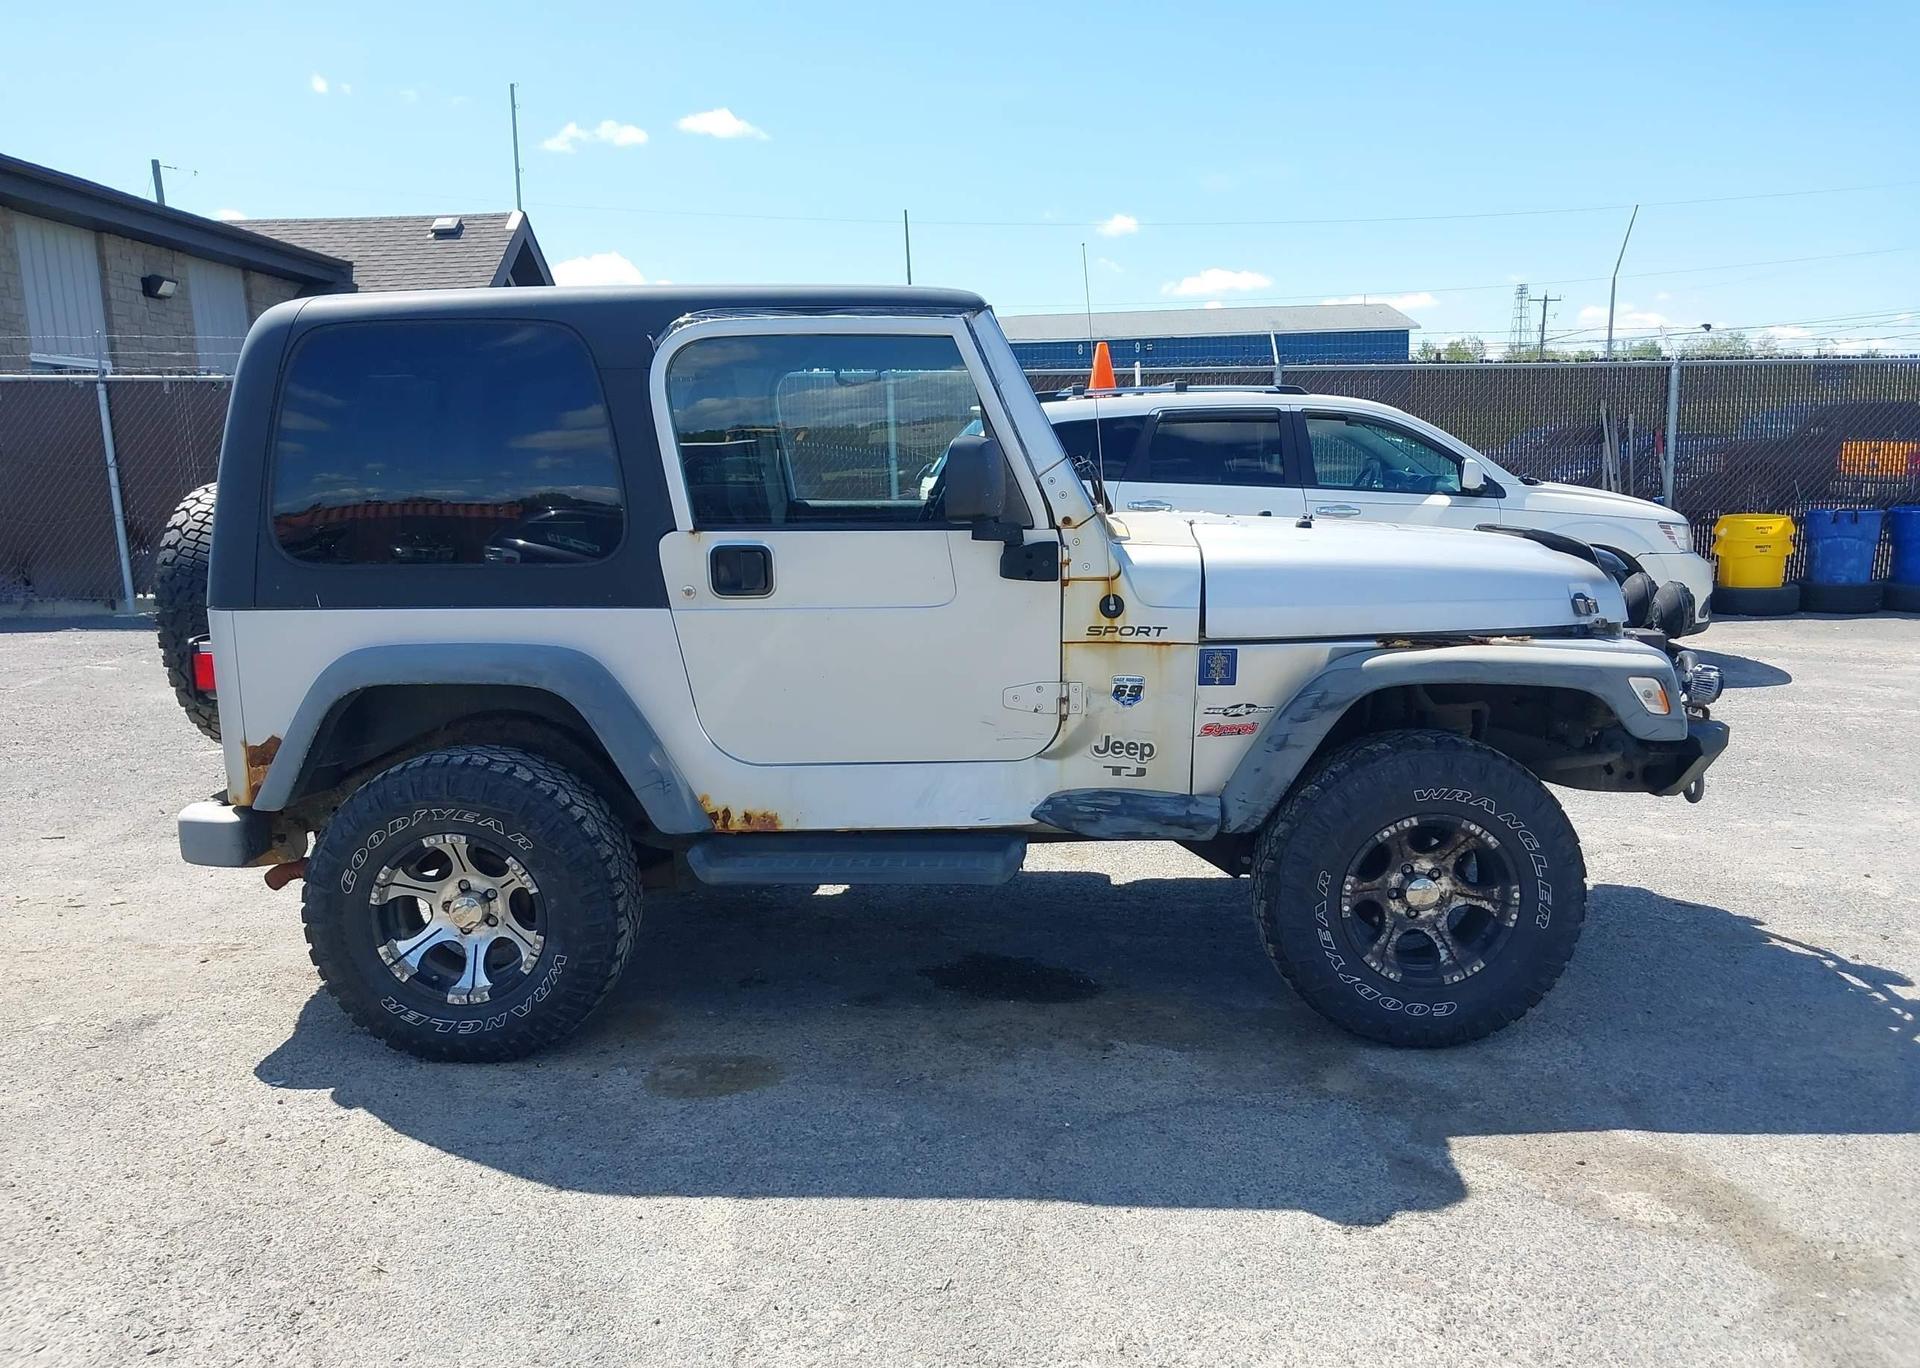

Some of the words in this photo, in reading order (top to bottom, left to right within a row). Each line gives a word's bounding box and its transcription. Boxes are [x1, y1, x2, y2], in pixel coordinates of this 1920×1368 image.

[1077, 344, 1084, 355] 8
[1134, 342, 1141, 353] 9
[1086, 626, 1168, 637] SPORT
[1112, 684, 1143, 698] 69
[1200, 722, 1259, 737] Synergy
[1093, 735, 1155, 761] Jeep
[1103, 766, 1147, 777] TJ
[340, 808, 534, 894] GOODYEAR
[1414, 788, 1552, 929] WRANGLER
[1314, 870, 1457, 1017] GOODYEAR
[381, 954, 568, 1034] WRANGLER
